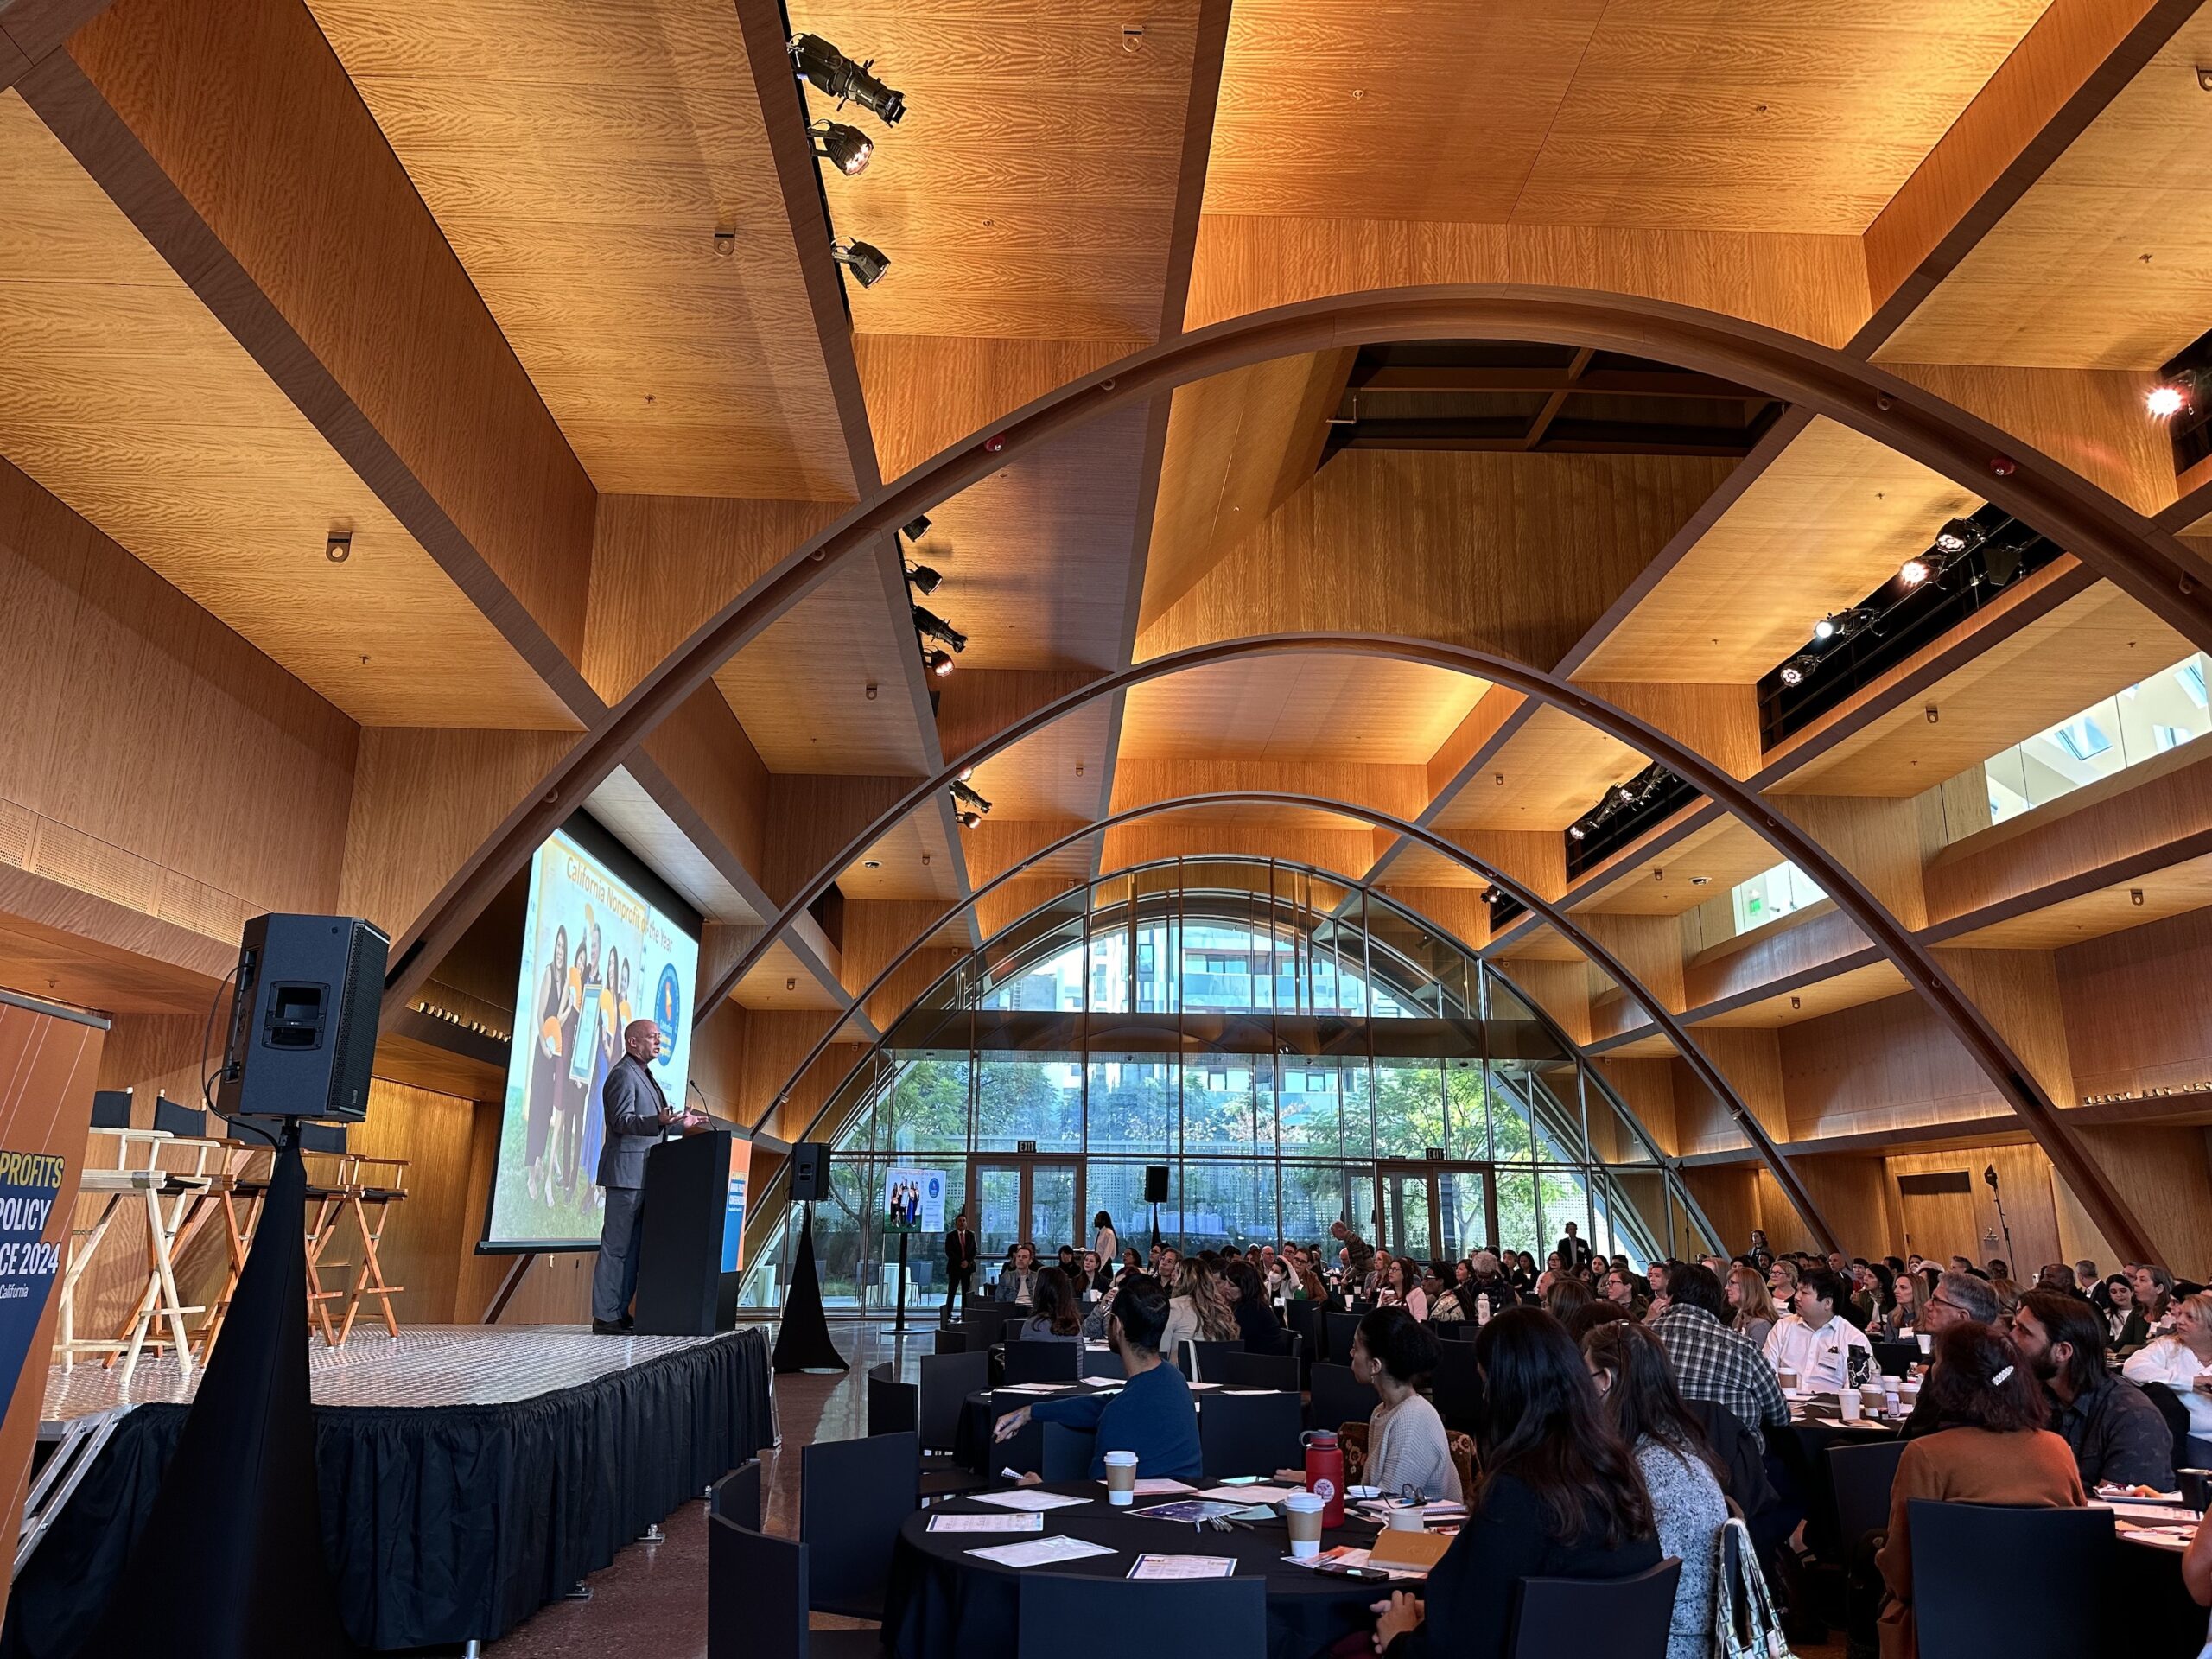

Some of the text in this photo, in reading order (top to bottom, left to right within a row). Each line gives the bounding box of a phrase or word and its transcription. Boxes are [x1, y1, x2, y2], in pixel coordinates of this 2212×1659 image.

[567, 856, 605, 902] California
[606, 887, 640, 929] Nonprofit
[649, 920, 659, 944] the
[660, 927, 673, 952] Year
[1020, 1141, 1034, 1152] EXIT
[1427, 1149, 1443, 1160] EXIT
[19, 1243, 60, 1275] 2024
[0, 1283, 29, 1300] California
